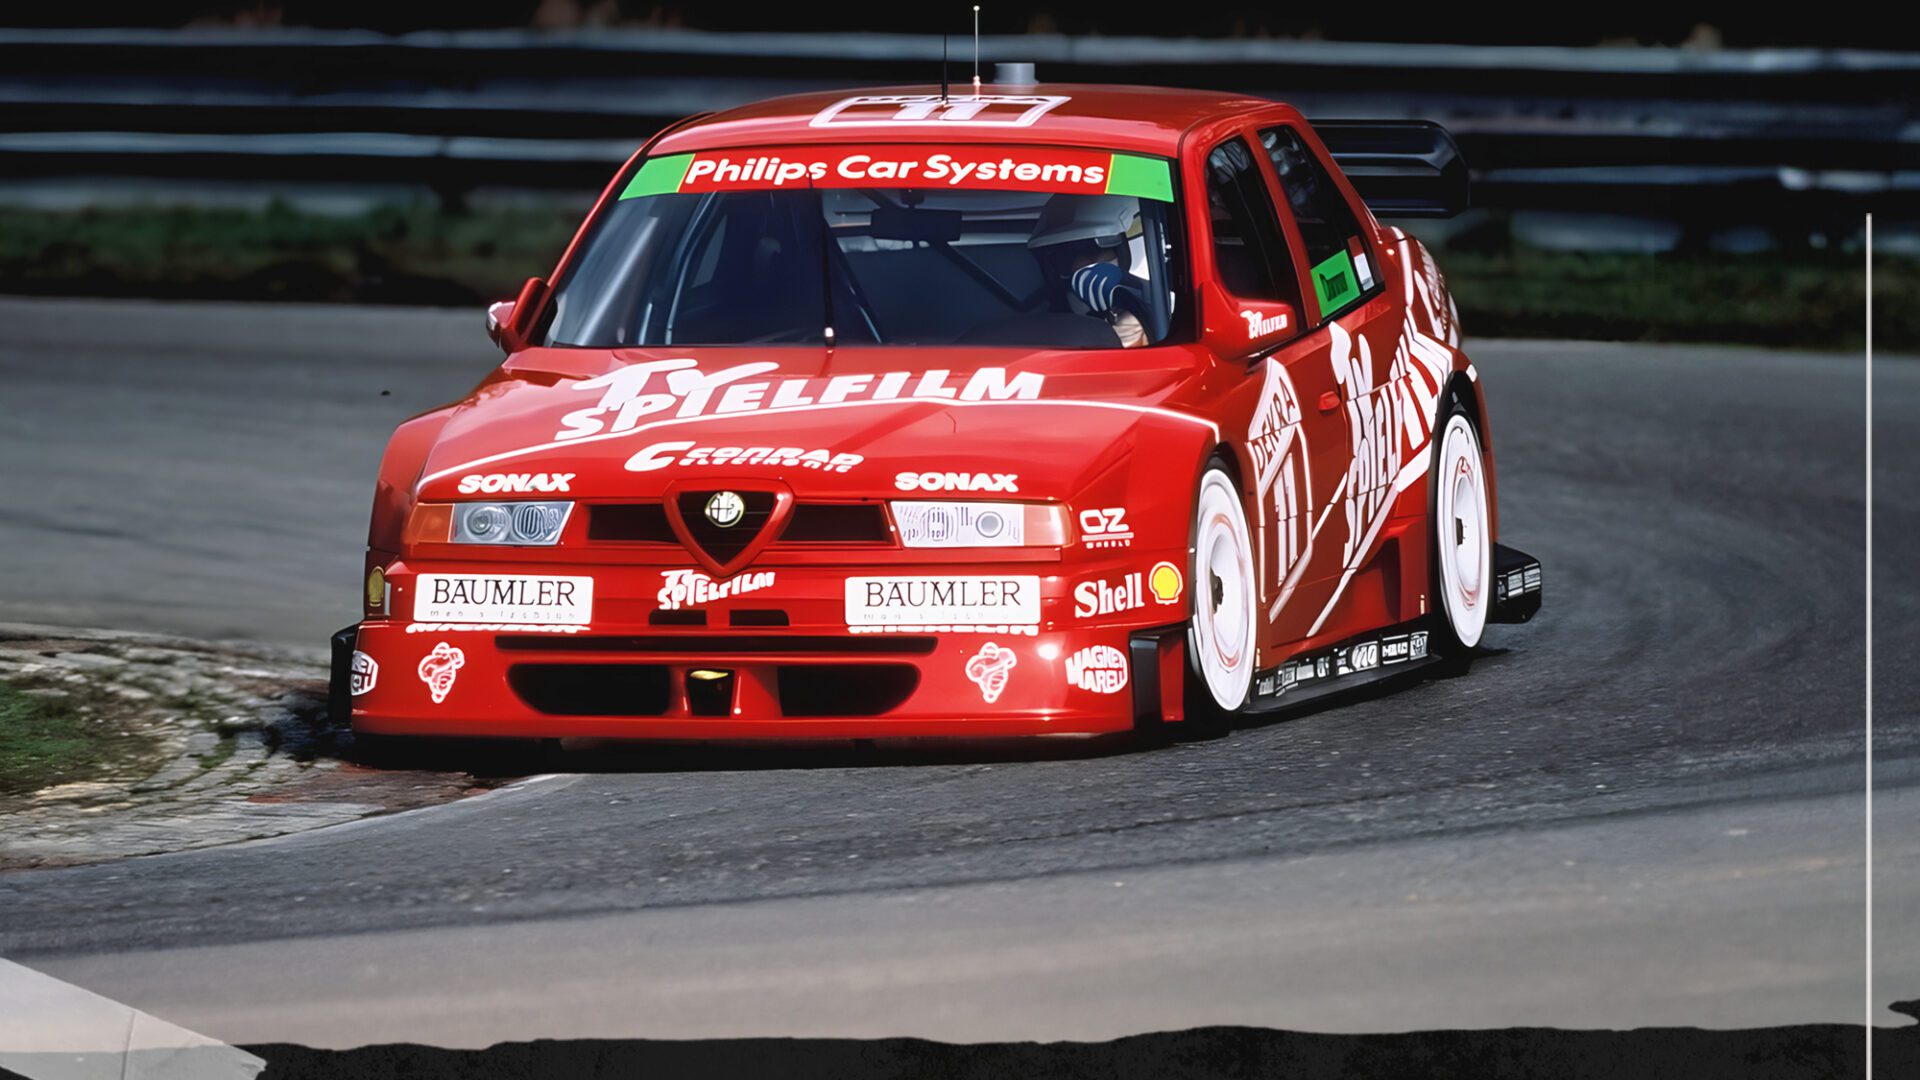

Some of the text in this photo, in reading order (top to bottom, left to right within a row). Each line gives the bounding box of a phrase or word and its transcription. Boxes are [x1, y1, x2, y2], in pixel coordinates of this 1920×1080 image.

[685, 154, 1105, 186] Philips Car Systems
[554, 367, 1046, 441] SPIELFILM
[1251, 376, 1296, 470] DEKRA
[457, 473, 576, 494] SONAX
[894, 472, 1019, 492] SONAX
[1080, 507, 1130, 534] OZ
[1074, 572, 1145, 618] Shell
